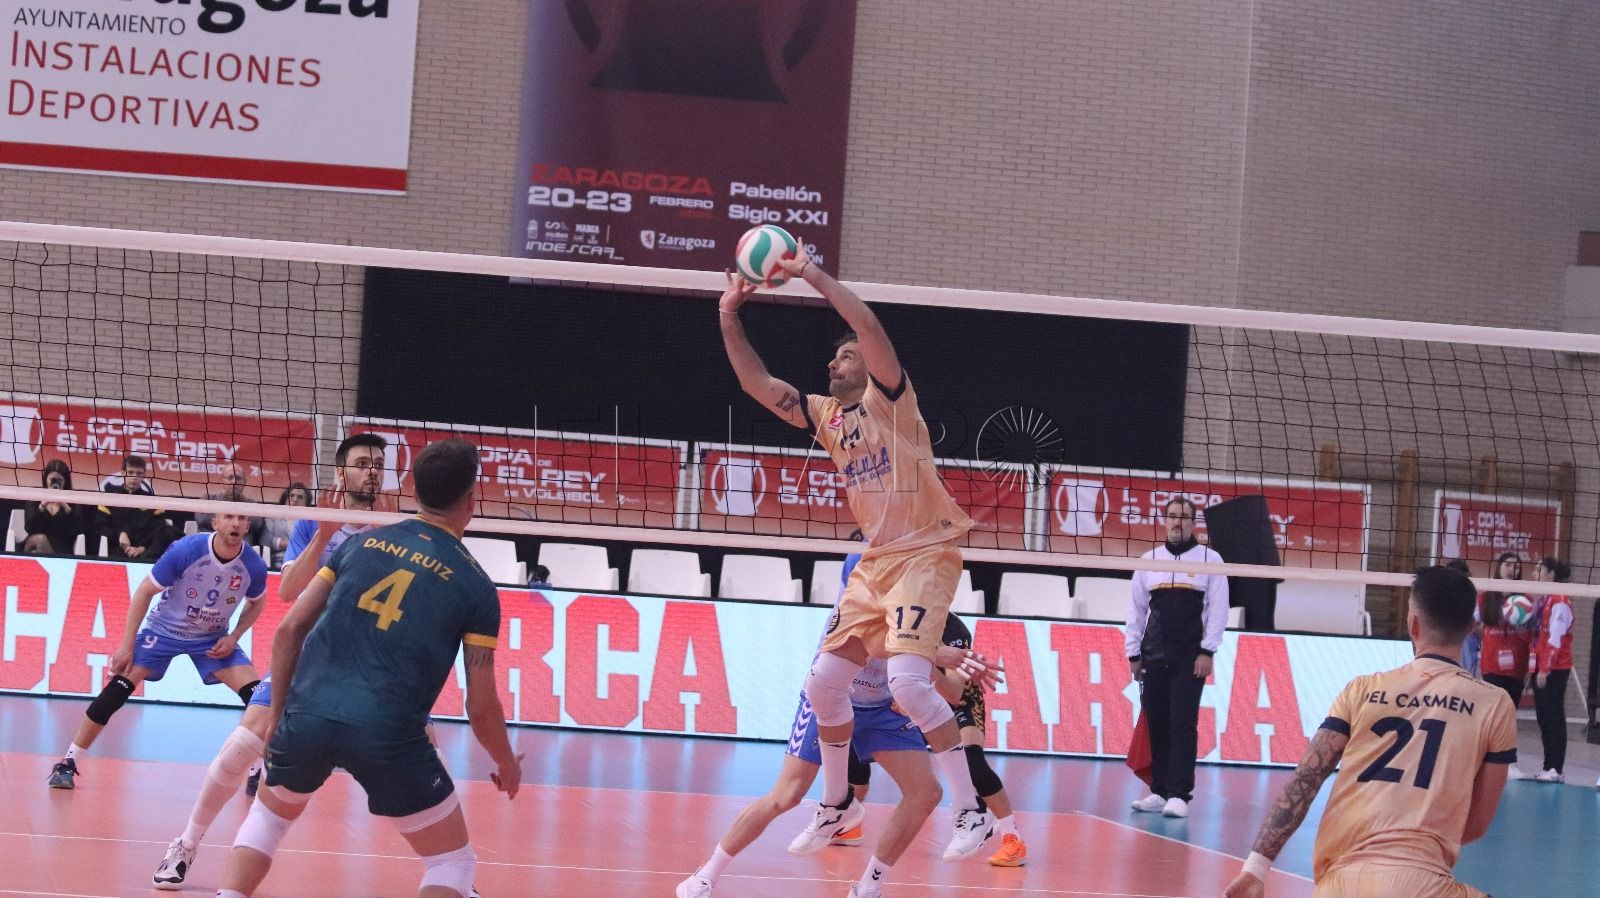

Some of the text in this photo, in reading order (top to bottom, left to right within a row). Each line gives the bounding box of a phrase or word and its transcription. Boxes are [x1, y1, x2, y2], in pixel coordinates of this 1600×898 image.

[13, 8, 186, 36] AYUNTAMIENTO
[529, 163, 714, 196] ZARAGOZA
[527, 185, 632, 213] 20-23
[649, 195, 714, 209] FEBRERO
[730, 181, 822, 203] Pabellón
[728, 204, 782, 224] Siglo
[785, 208, 829, 226] XXI
[658, 232, 716, 251] Zaragoza
[87, 417, 167, 438] COPA
[56, 433, 241, 462] S.M. EL REY
[477, 445, 534, 466] OPA
[497, 465, 531, 486] EL
[541, 468, 607, 491] REY
[523, 487, 605, 504] VOLEIBOL
[777, 485, 843, 508] S.M.
[1478, 511, 1507, 529] COPA
[1493, 530, 1507, 548] EL
[1508, 530, 1532, 549] REY
[363, 538, 409, 558] DANI
[410, 552, 455, 581] RUIZ
[205, 589, 220, 607] 9
[357, 568, 416, 631] 4
[895, 605, 927, 630] 17
[141, 635, 159, 649] 9
[1356, 716, 1448, 789] 21
